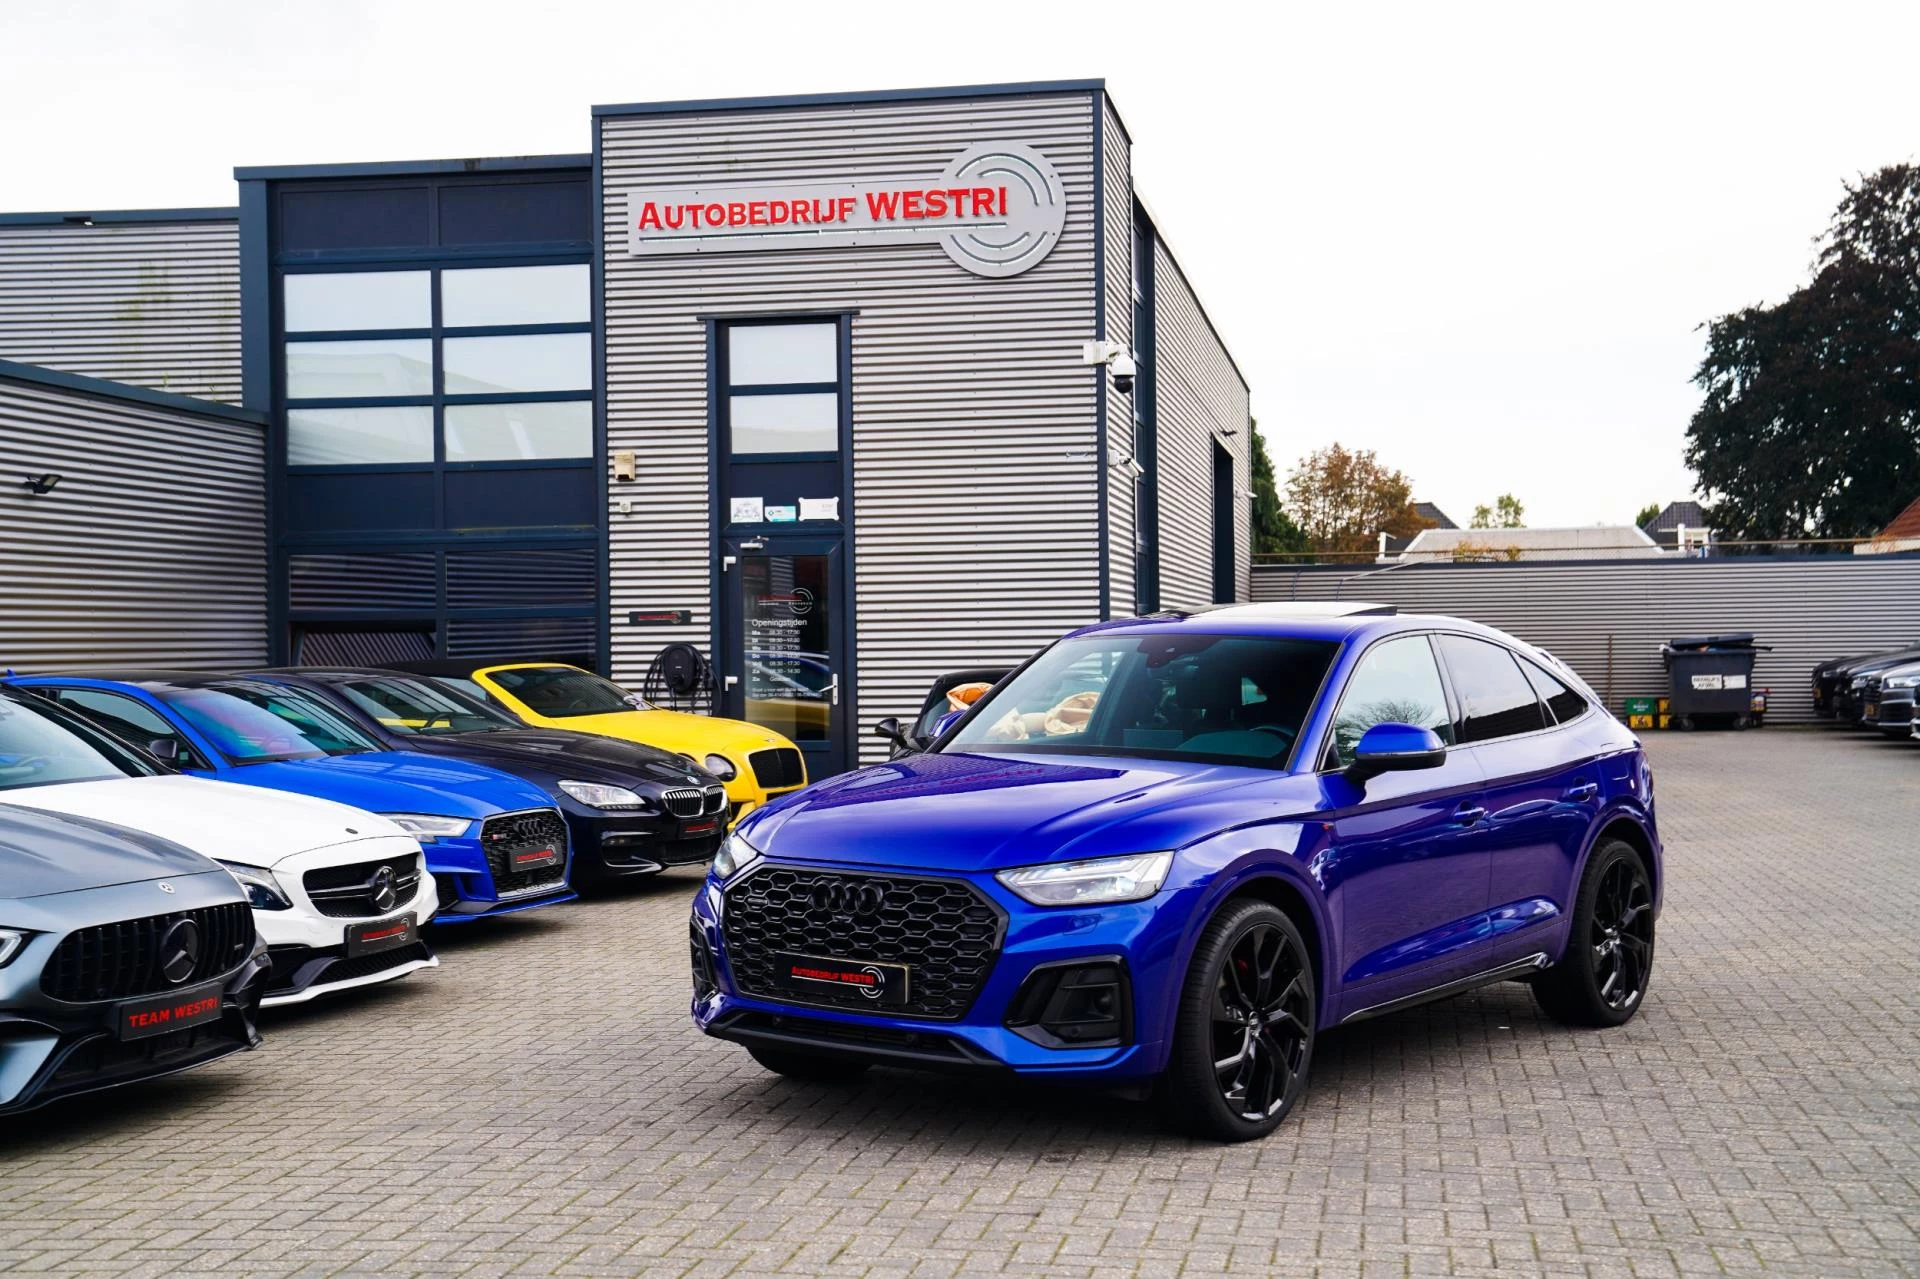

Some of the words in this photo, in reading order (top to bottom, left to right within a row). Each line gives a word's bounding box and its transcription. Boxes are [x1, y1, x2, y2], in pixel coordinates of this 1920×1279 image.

[638, 198, 857, 231] AUTOBEDRIJF
[866, 186, 1008, 222] WESTRI
[752, 619, 807, 627] Openingstijden
[840, 972, 875, 985] WESTRI
[129, 1009, 171, 1028] TEAM
[174, 996, 218, 1019] WESTRI
